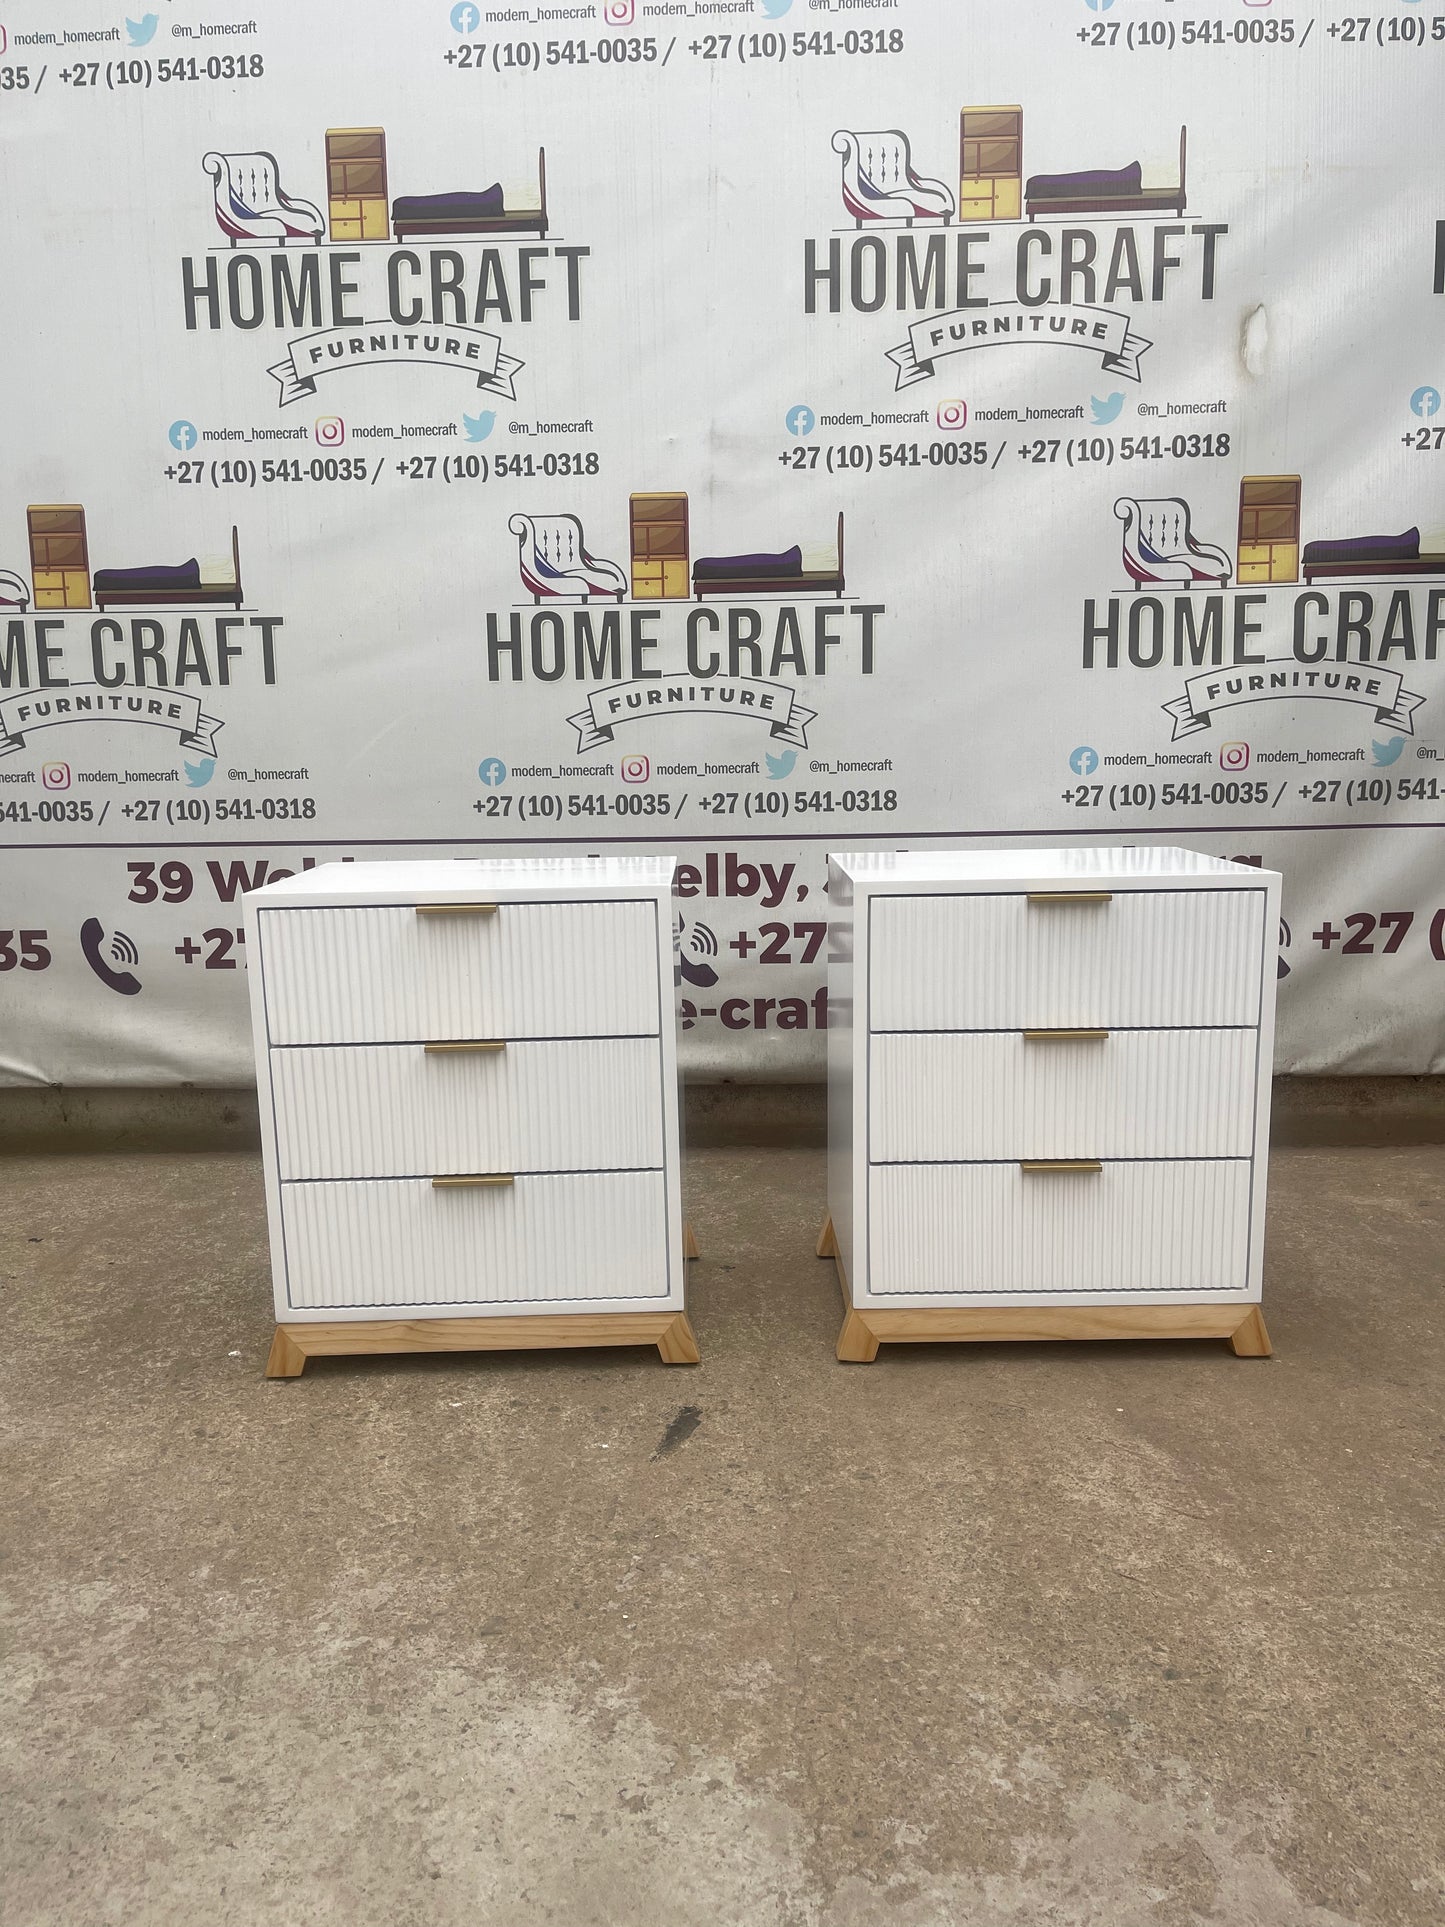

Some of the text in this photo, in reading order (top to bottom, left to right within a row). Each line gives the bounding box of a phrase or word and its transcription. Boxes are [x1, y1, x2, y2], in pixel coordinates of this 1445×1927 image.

[172, 20, 257, 38] @m_homecraft
[1077, 23, 1120, 46] +27
[1127, 21, 1175, 50] (10)
[1182, 19, 1294, 44] 541-0035
[1327, 18, 1370, 41] +27
[1377, 17, 1425, 46] (10)
[444, 44, 486, 68] +27
[493, 42, 540, 72] (10)
[546, 38, 657, 65] 541-0035
[689, 35, 731, 59] +27
[738, 33, 786, 63] (10)
[793, 29, 903, 56] 541-0318
[59, 63, 99, 86] +27
[107, 60, 151, 90] (10)
[158, 54, 263, 82] 541-0318
[804, 224, 1228, 313] HOME CRAFT
[182, 246, 591, 330] HOME CRAFT
[930, 315, 1108, 346] FURNITURE
[310, 334, 480, 363] FURNITURE
[1138, 400, 1226, 417] @m_homecraft
[509, 420, 593, 436] @m_homecraft
[779, 447, 820, 469] +27
[827, 445, 872, 473] (10)
[879, 442, 987, 467] 541-0035
[1018, 440, 1060, 462] +27
[1067, 438, 1114, 467] (10)
[1120, 433, 1230, 459] 541-0318
[164, 461, 204, 483] +27
[211, 460, 256, 488] (10)
[262, 458, 366, 482] 541-0035
[396, 457, 436, 479] +27
[443, 455, 488, 483] (10)
[495, 453, 599, 477] 541-0318
[486, 605, 885, 681] HOME CRAFT
[1083, 589, 1445, 668] HOME CRAF
[90, 617, 284, 687] CRAFT
[608, 687, 775, 714] FURNITURE
[1207, 672, 1381, 700] FURNITURE
[18, 695, 182, 721] FURNITURE
[810, 759, 892, 774] @m_homecraft
[1417, 747, 1444, 761] @m_
[228, 768, 309, 782] @m_homecraft
[473, 796, 512, 816] +27
[519, 795, 562, 821] (10)
[568, 794, 670, 816] 541-0035
[699, 793, 738, 814] +27
[745, 792, 788, 818] (10)
[794, 790, 897, 812] 541-0318
[1062, 785, 1103, 806] +27
[1110, 784, 1155, 811] (10)
[1162, 782, 1268, 805] 541-0035
[1299, 781, 1341, 802] +27
[1347, 779, 1391, 806] (10)
[122, 800, 160, 821] +27
[167, 800, 210, 825] (10)
[216, 798, 316, 820] 541-0318
[127, 861, 193, 903] 39
[175, 928, 248, 969] +2
[730, 922, 828, 964] +27
[1313, 912, 1414, 954] +27
